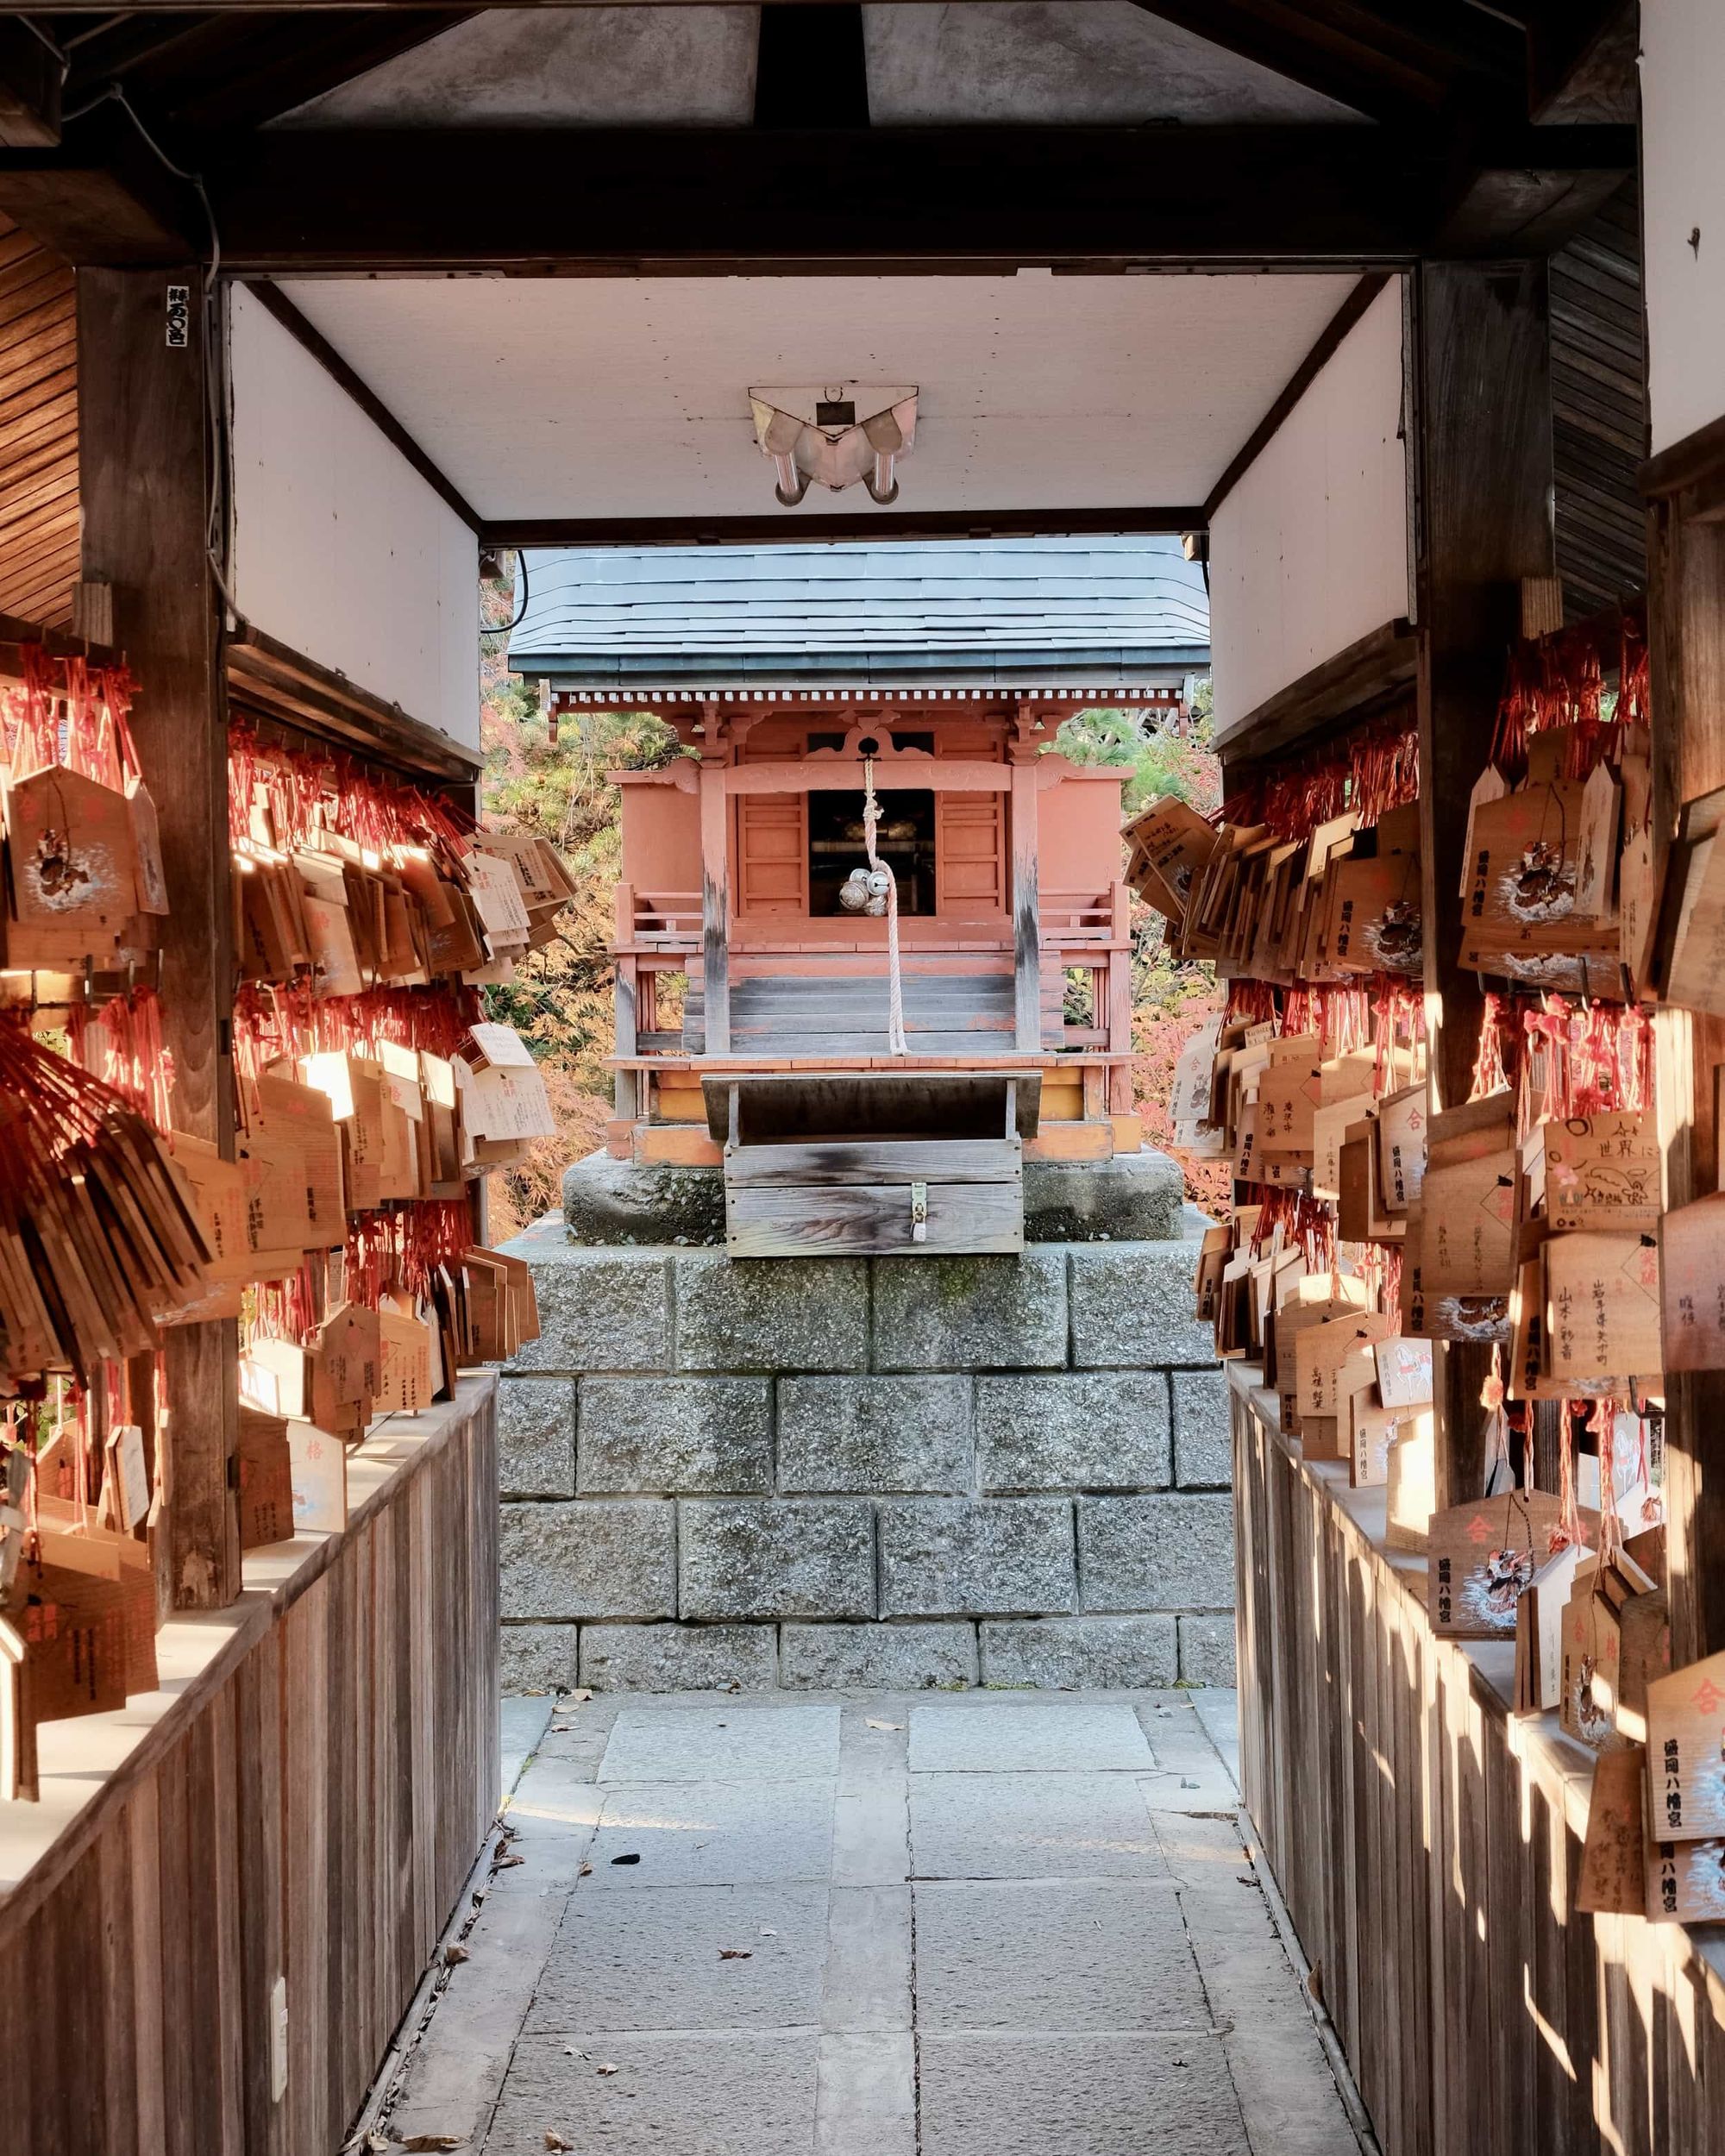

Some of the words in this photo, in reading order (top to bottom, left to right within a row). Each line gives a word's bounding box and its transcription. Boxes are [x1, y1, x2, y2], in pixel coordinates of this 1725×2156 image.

[1407, 1107, 1426, 1131] 合
[1239, 1133, 1254, 1176] 盛岡八幡宮
[1392, 1145, 1405, 1203] 盛岡八幡宮
[306, 1440, 324, 1460] 格
[1358, 1427, 1368, 1480] 盛岡八幡宮
[1465, 1514, 1496, 1544] 合
[1438, 1557, 1452, 1623] 盛岡八幡宮
[1690, 1678, 1725, 1716] 合
[1663, 1738, 1683, 1828] 盛岡八幡宮
